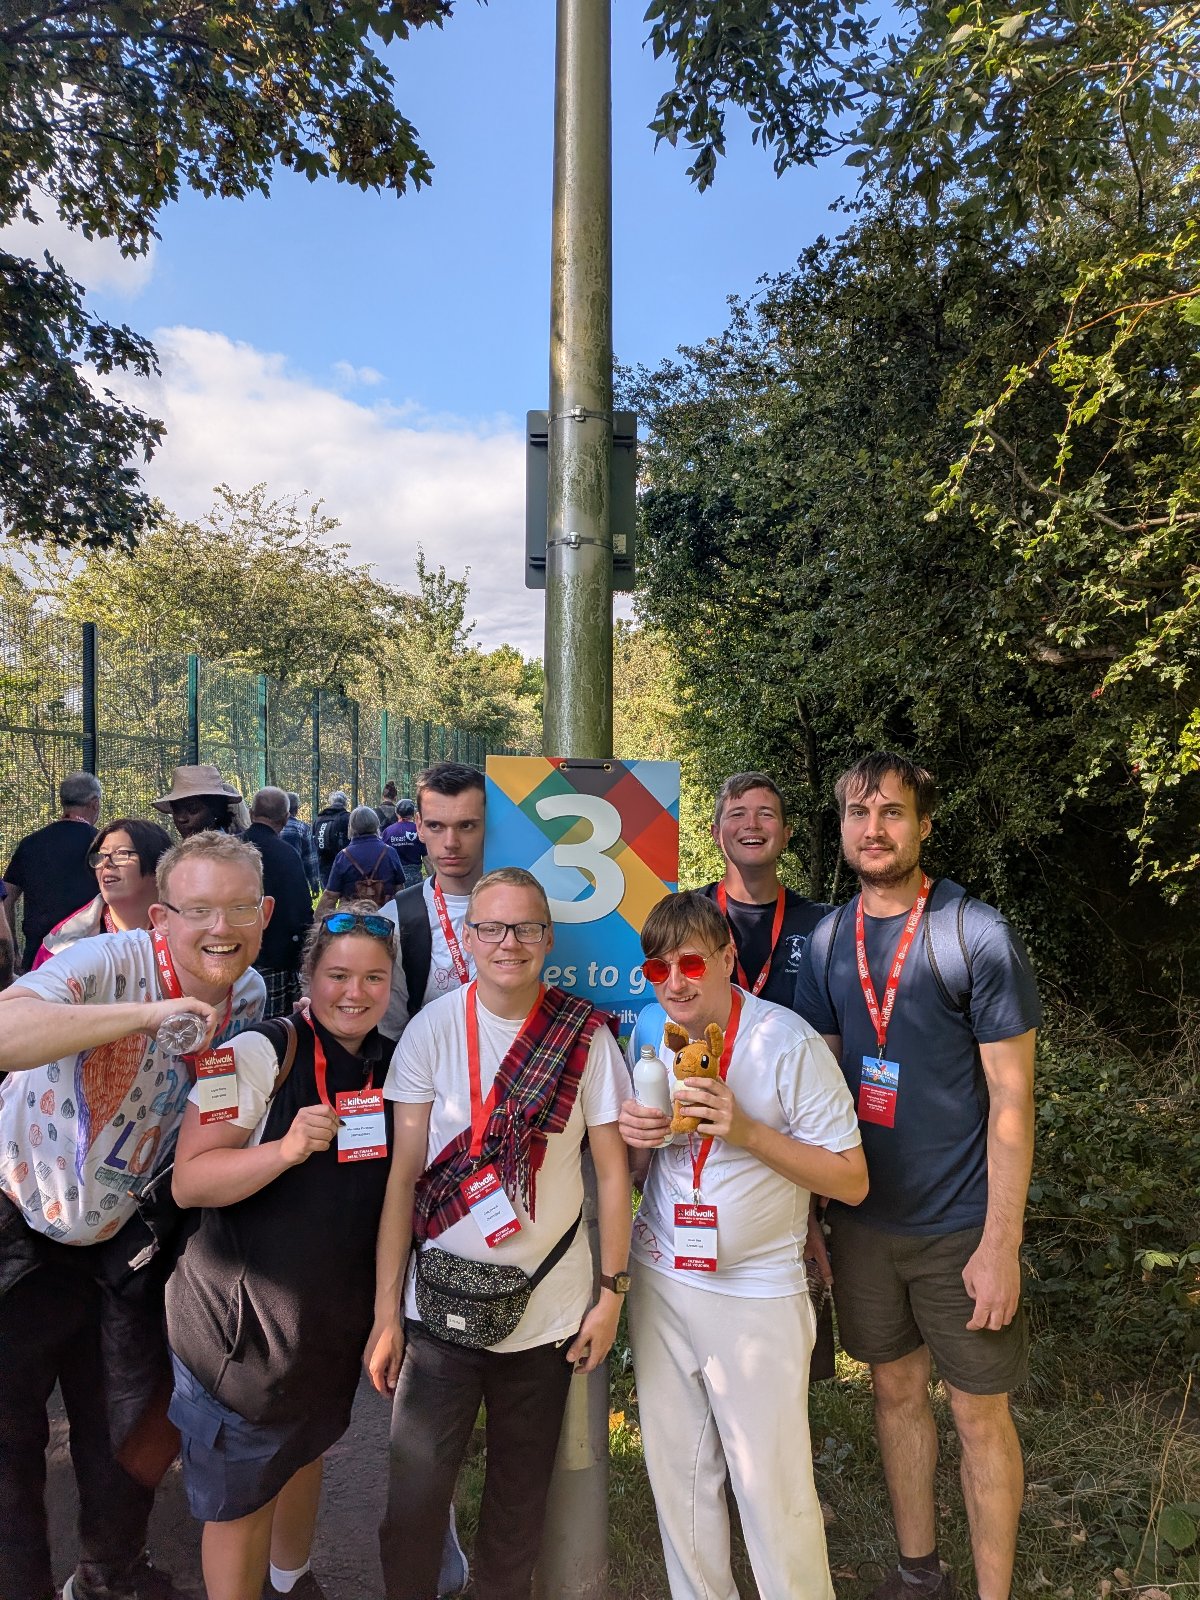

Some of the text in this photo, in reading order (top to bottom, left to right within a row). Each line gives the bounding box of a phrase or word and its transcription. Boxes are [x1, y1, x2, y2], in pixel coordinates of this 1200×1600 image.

[317, 822, 327, 849] adidas
[535, 793, 625, 923] 3
[908, 896, 927, 931] kiltwalk
[450, 944, 466, 977] kiltwalk
[856, 945, 869, 980] kiltwalk
[543, 961, 647, 995] es to g
[884, 987, 896, 1024] kiltwalk
[204, 1053, 233, 1066] kiltwalk
[347, 1095, 381, 1106] kiltwalk
[103, 1120, 162, 1175] LO
[469, 1172, 495, 1193] kiltwalk
[684, 1208, 715, 1218] kiltwalk
